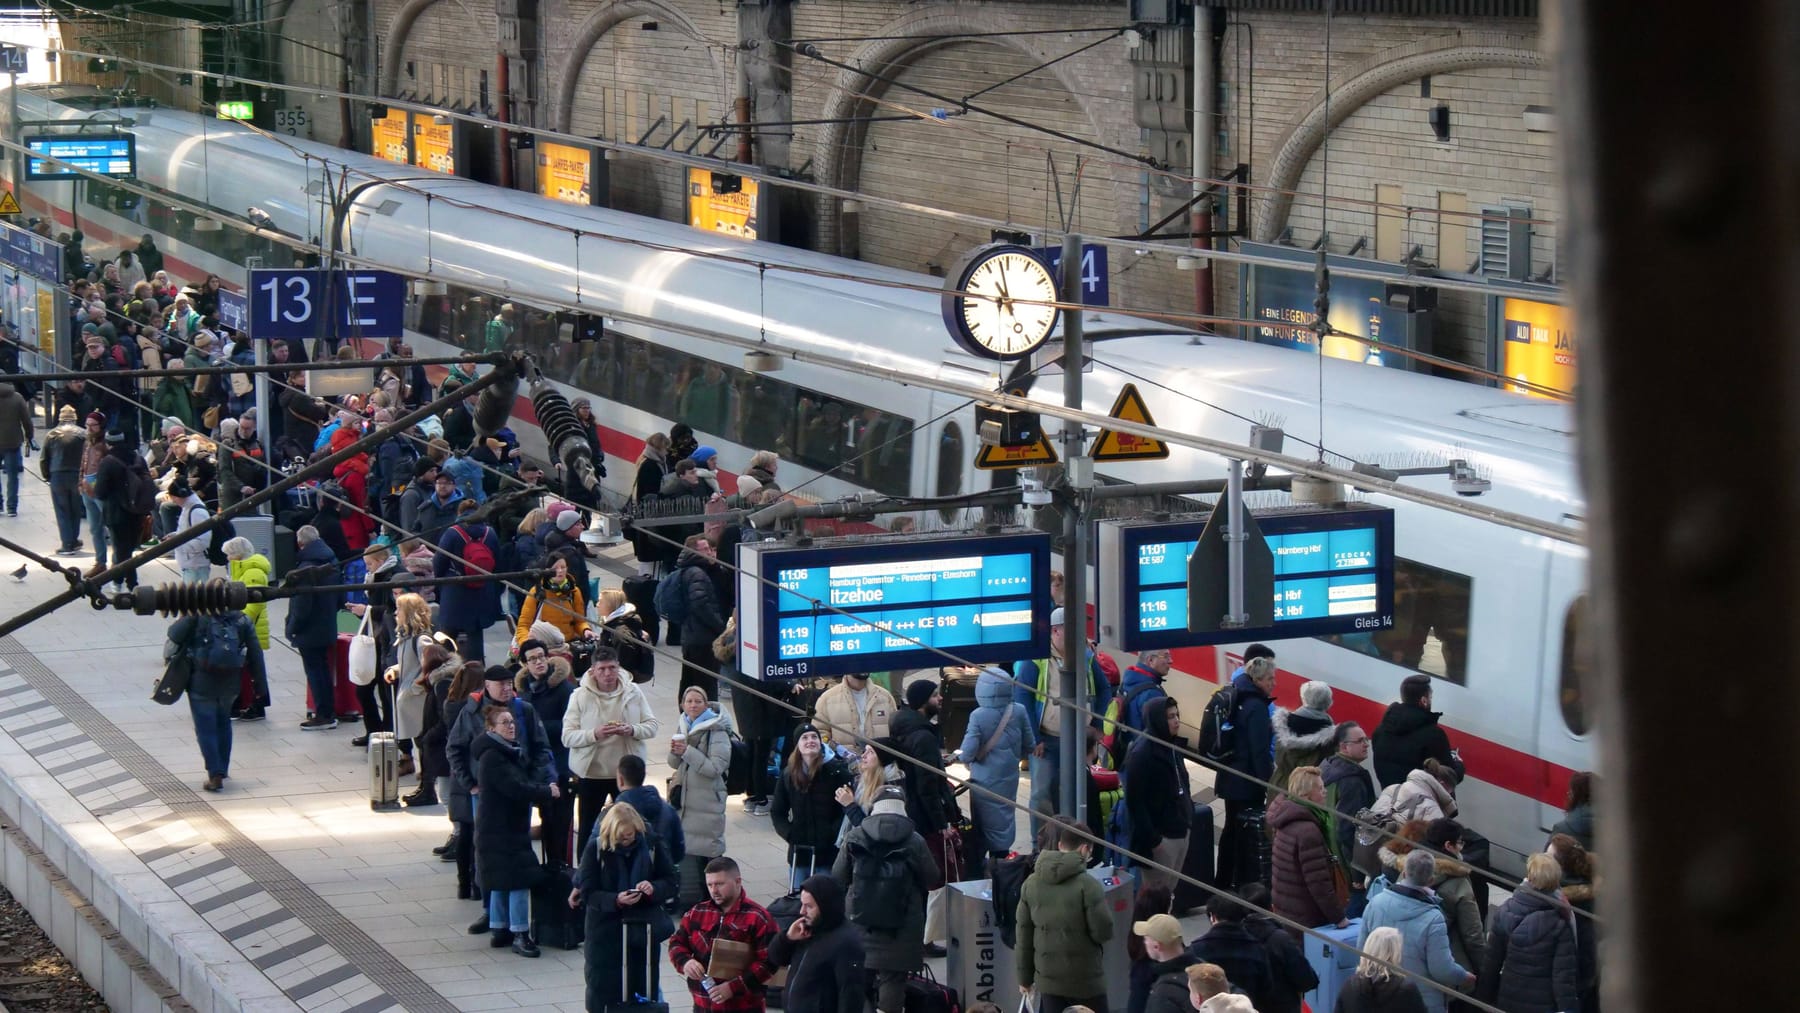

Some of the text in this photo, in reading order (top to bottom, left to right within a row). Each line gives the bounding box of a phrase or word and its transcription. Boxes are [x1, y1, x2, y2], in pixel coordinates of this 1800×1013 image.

[1, 48, 24, 68] 14
[277, 111, 306, 126] 355
[260, 276, 312, 323] 13
[347, 276, 377, 325] E
[1266, 308, 1280, 320] EINE
[1260, 326, 1274, 337] VON
[1516, 325, 1549, 343] ALDI TALK
[1141, 544, 1166, 556] 11:01
[1277, 546, 1308, 555] Nürnberg
[1309, 544, 1322, 553] Hbf
[1139, 556, 1151, 565] ICE
[780, 569, 808, 581] 11:06
[830, 577, 861, 588] Hamburg
[862, 575, 894, 585] Dammtor
[902, 573, 937, 583] Pinneberg
[943, 570, 977, 580] Elmshorn
[790, 581, 799, 590] 61
[830, 588, 883, 604] Itzehoe
[1285, 589, 1302, 601] Hbf
[1141, 601, 1167, 612] 11:16
[1286, 604, 1304, 616] Hbf
[780, 627, 809, 639] 11:19
[830, 623, 872, 635] München
[875, 620, 893, 632] Hbf
[918, 617, 935, 628] ICE
[937, 615, 958, 627] 618
[1141, 617, 1167, 628] 11:24
[1355, 616, 1392, 629] Gleis 14
[780, 643, 809, 656] 12:06
[830, 640, 844, 651] RB
[847, 639, 860, 650] 61
[766, 662, 808, 676] Gleis 13
[976, 932, 994, 1003] Abfall
